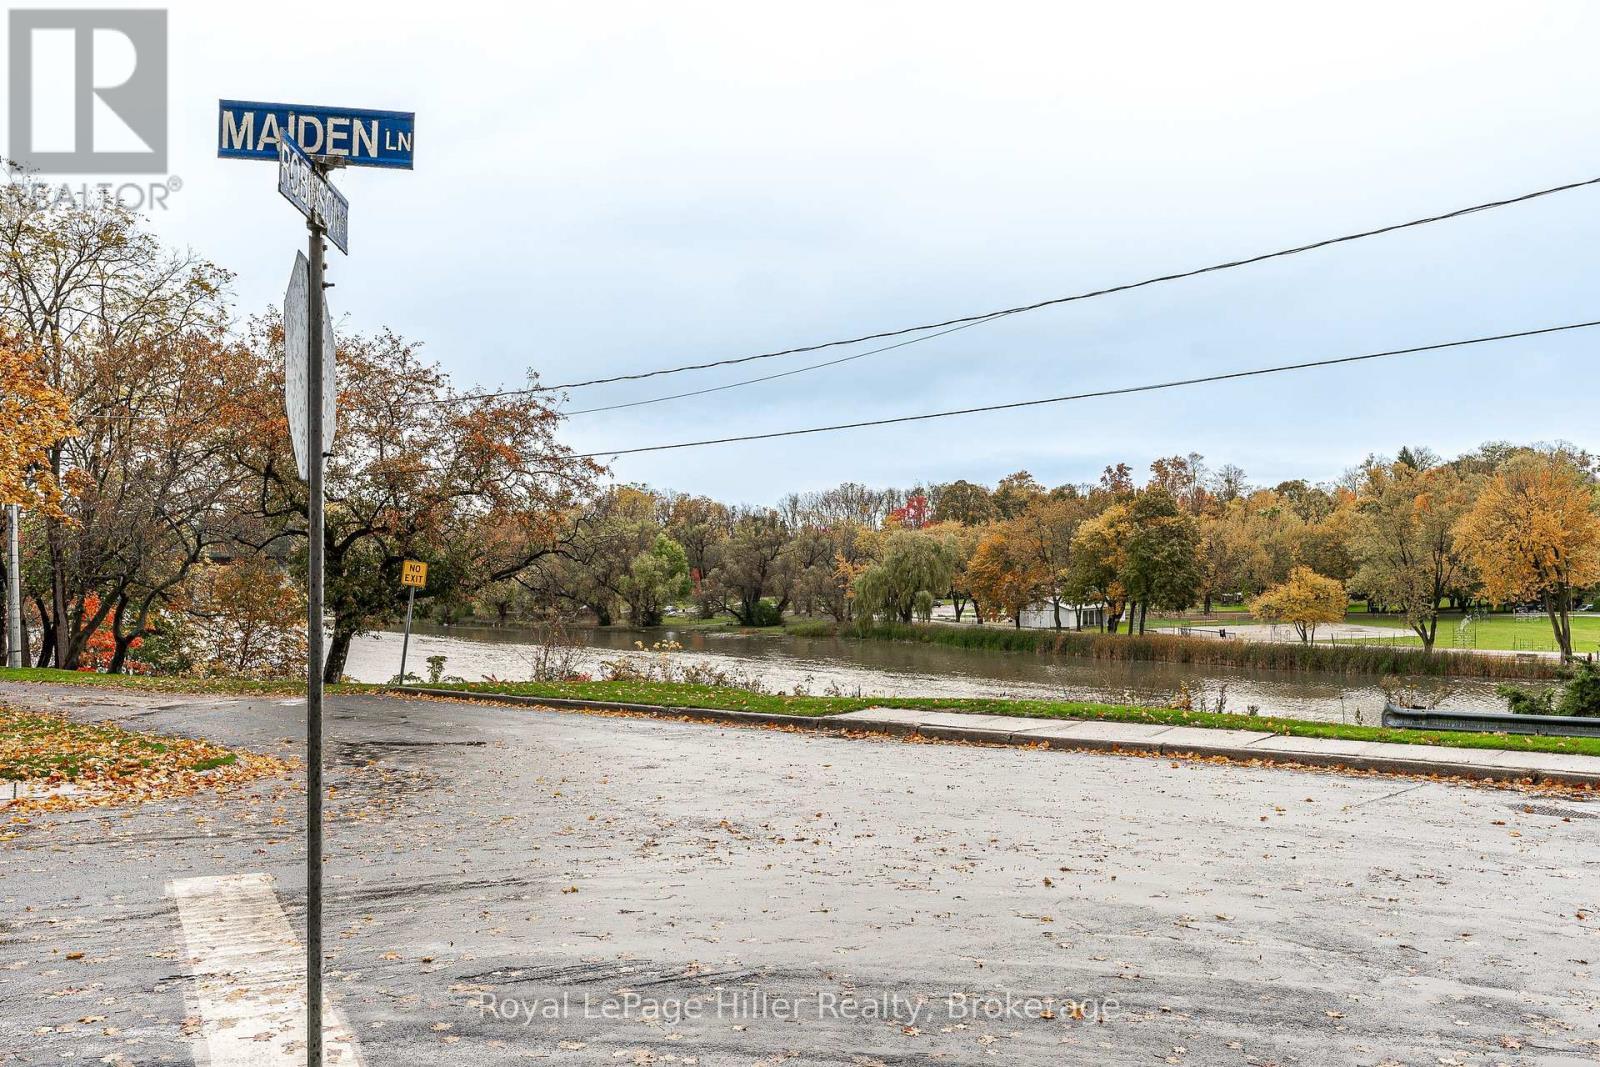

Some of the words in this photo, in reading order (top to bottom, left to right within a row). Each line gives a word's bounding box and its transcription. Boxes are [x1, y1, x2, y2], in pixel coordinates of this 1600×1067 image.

[222, 110, 379, 158] MAIDEN
[385, 128, 411, 152] LN
[410, 564, 421, 573] NO
[404, 574, 423, 584] EXIT
